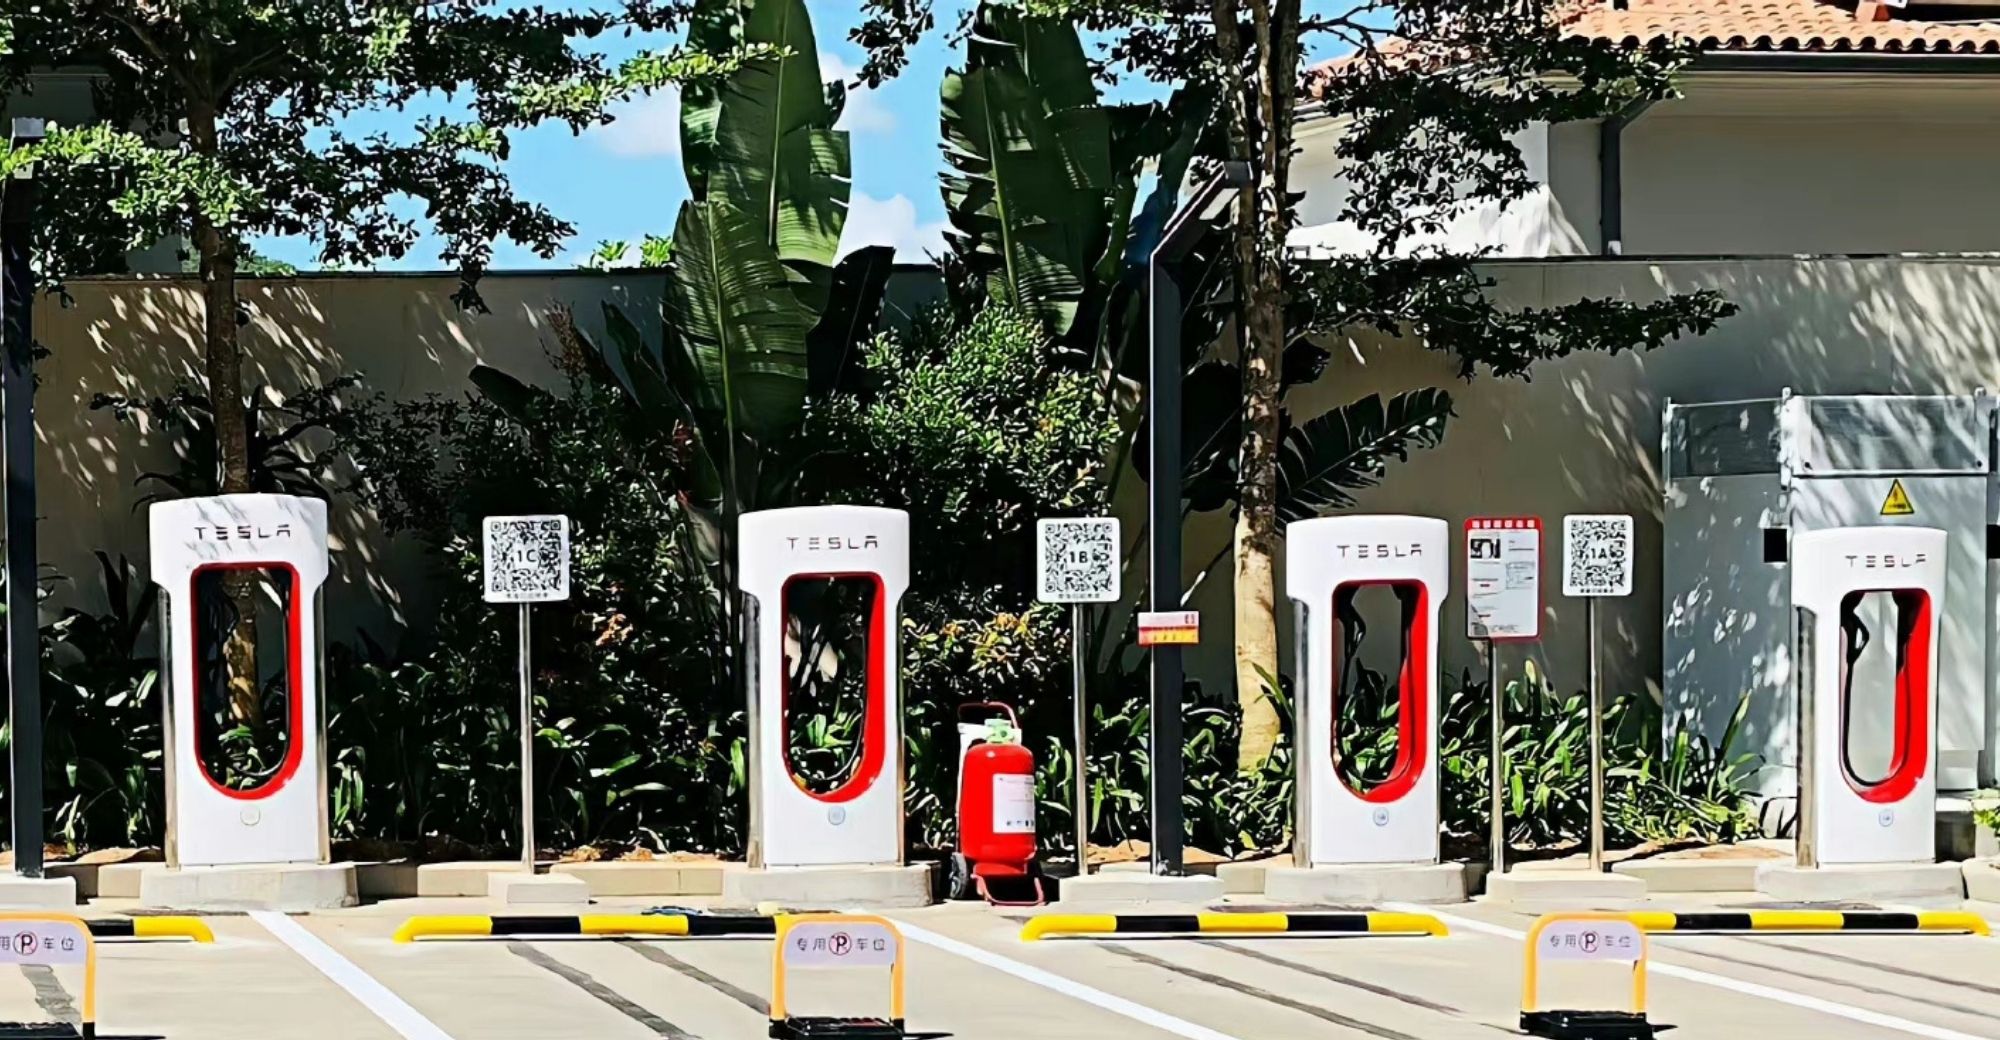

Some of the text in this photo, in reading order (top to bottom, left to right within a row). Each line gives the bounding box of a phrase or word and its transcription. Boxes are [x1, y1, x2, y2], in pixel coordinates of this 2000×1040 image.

[194, 524, 291, 540] TESLA
[786, 535, 878, 550] TESLA
[517, 549, 537, 562] 1C
[1070, 551, 1088, 563] 1B
[1336, 544, 1422, 558] TESLA
[1591, 548, 1607, 559] 1A
